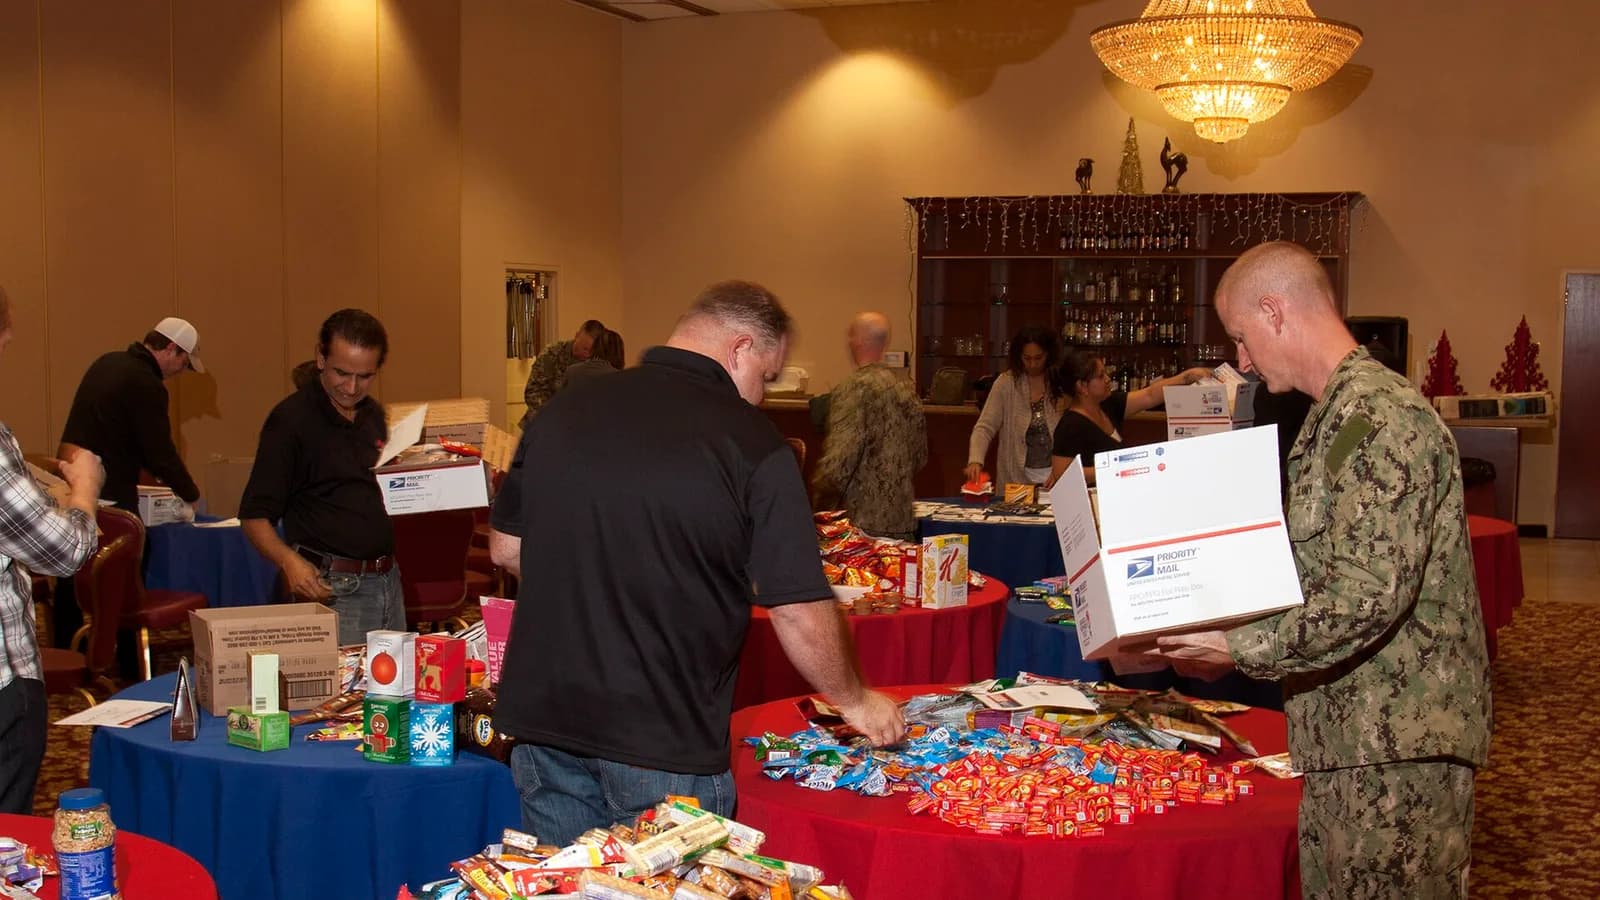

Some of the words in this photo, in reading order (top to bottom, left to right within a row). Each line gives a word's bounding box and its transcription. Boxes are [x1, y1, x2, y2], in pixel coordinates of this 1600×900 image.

[1157, 548, 1197, 561] PRIORITY
[1157, 564, 1180, 575] MAIL
[488, 641, 498, 683] VALUE
